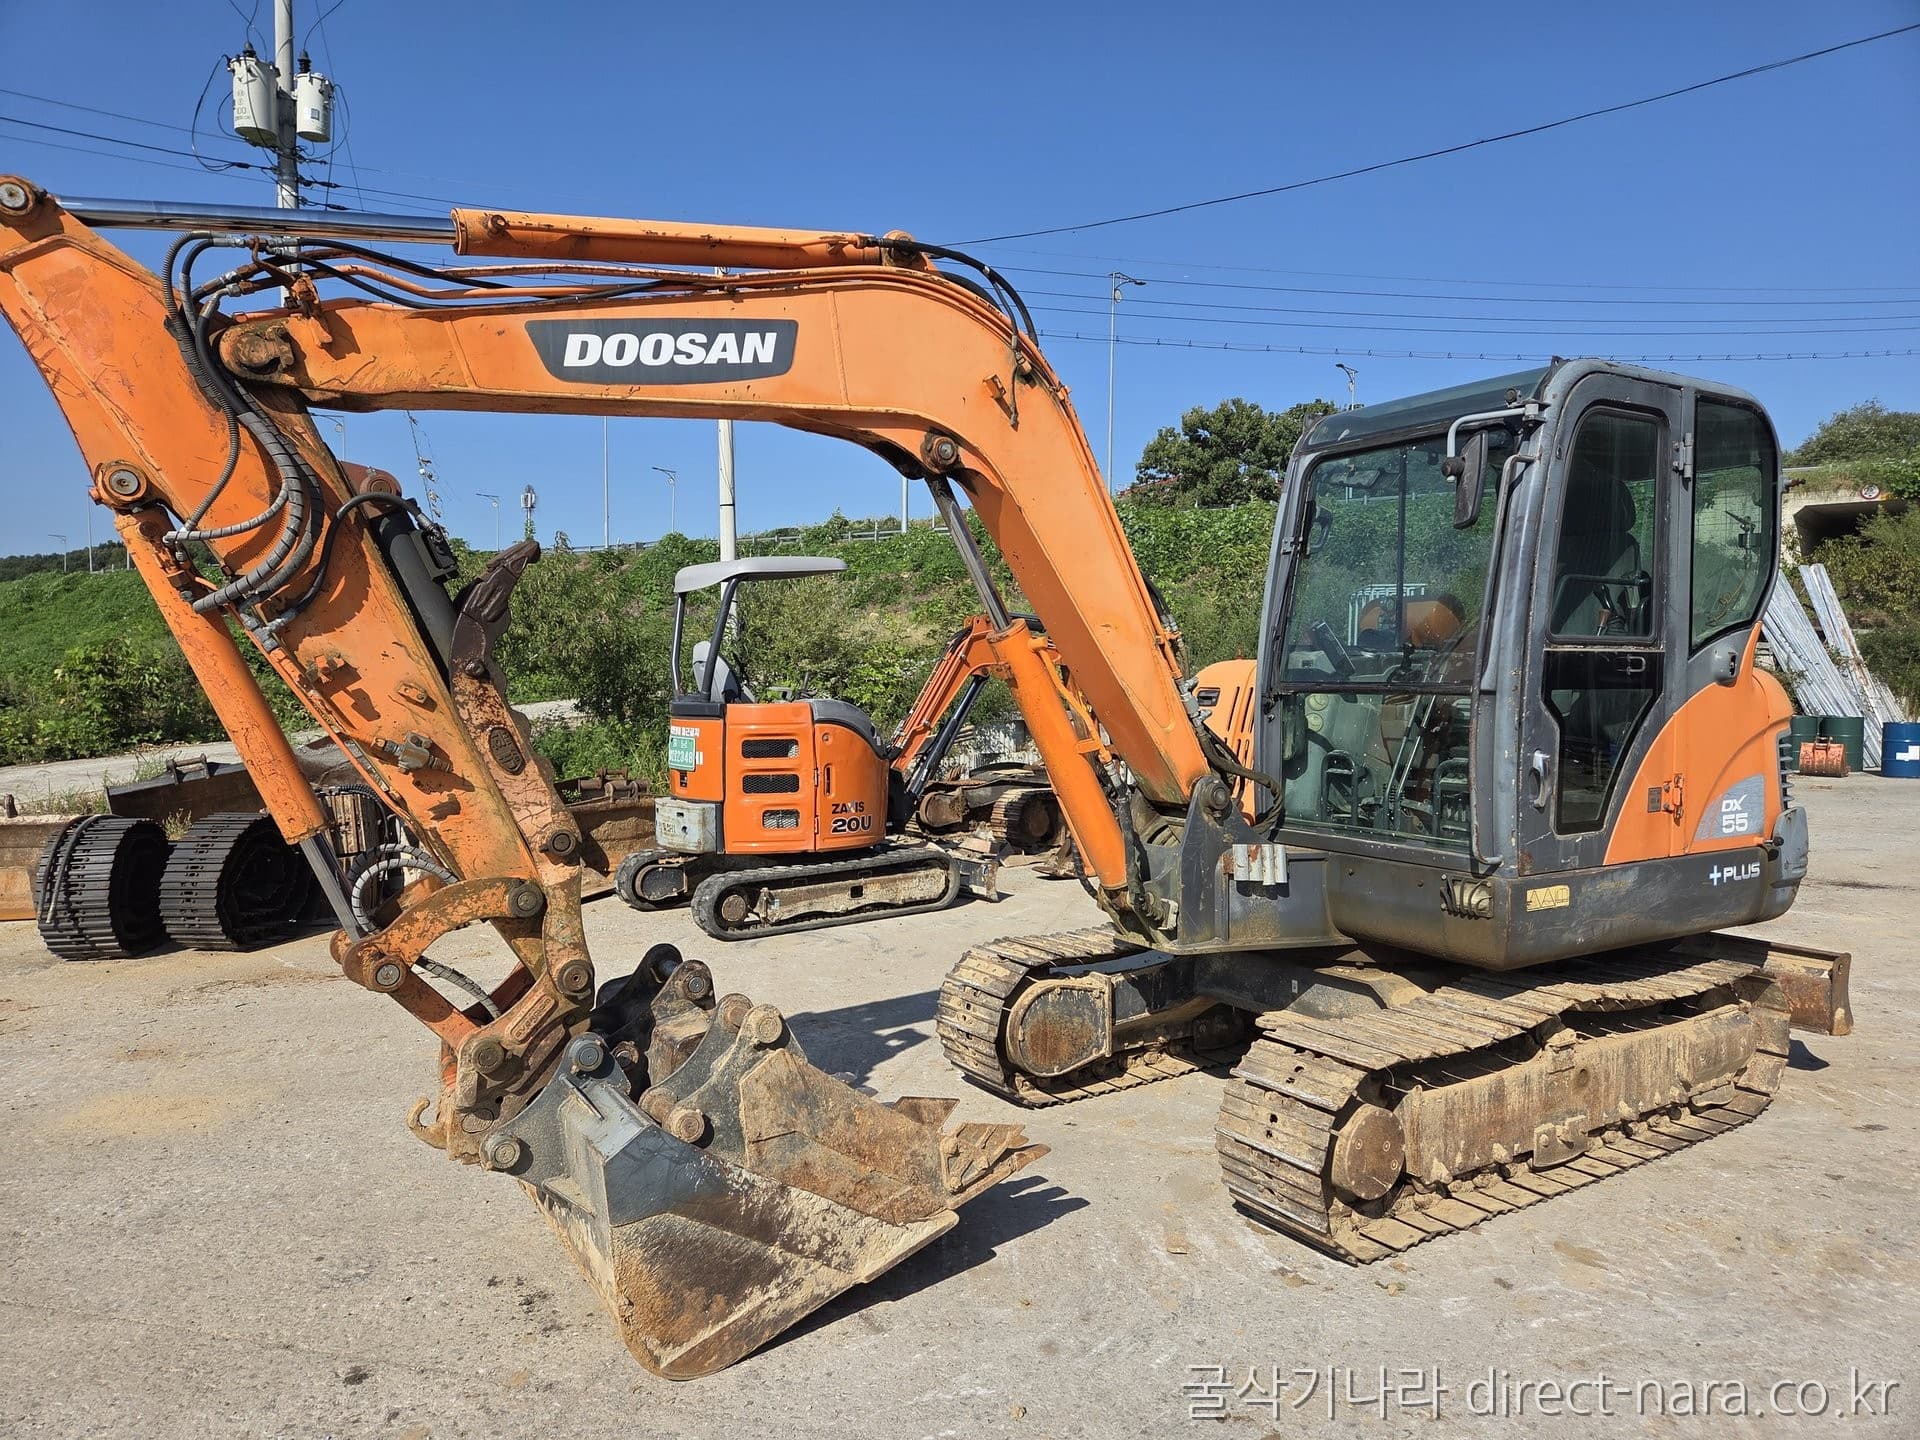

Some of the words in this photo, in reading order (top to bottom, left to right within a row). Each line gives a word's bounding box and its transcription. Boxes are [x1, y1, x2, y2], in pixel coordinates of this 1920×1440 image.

[564, 332, 777, 367] DOOSAN
[1721, 794, 1748, 812] DX
[831, 815, 872, 834] 20U
[1722, 812, 1748, 834] 55
